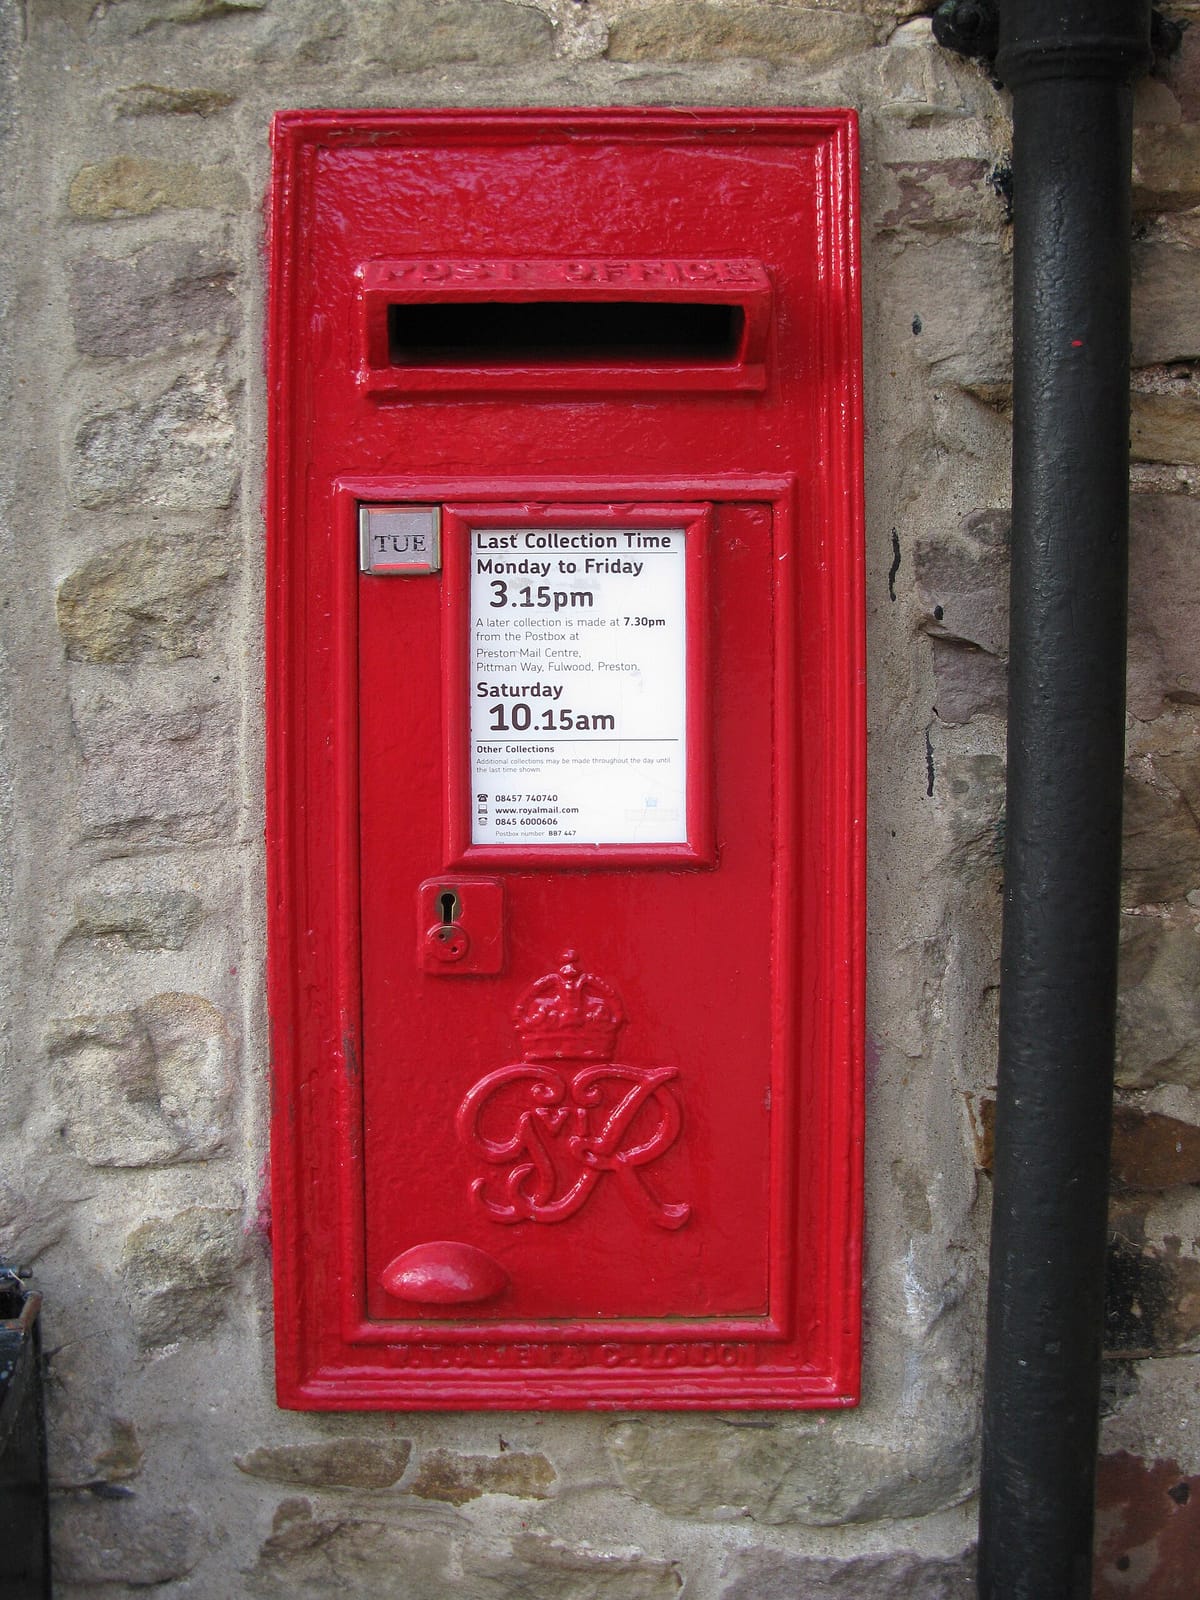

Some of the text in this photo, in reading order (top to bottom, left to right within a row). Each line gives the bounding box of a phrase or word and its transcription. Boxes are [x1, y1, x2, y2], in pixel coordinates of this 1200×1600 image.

[374, 535, 426, 553] TUE
[477, 533, 671, 549] Last Collection Time
[478, 558, 643, 577] Monday to Friday
[490, 580, 593, 612] 3.15pm
[476, 617, 665, 628] A later collection is made at 7.30pm
[477, 631, 579, 641] from the Postbox at
[477, 648, 515, 658] Preston
[519, 648, 541, 657] Mail
[477, 662, 517, 672] Pittman
[477, 682, 563, 700] Saturday
[489, 703, 614, 731] 10.15am
[506, 745, 554, 753] Collections
[545, 758, 560, 766] may
[561, 757, 571, 765] be
[572, 757, 590, 765] made
[591, 757, 629, 766] throughout
[642, 757, 655, 766] day
[495, 794, 559, 803] 08457 740740
[496, 806, 579, 815] www.royalmail.com
[495, 817, 559, 826] 0845 6000606
